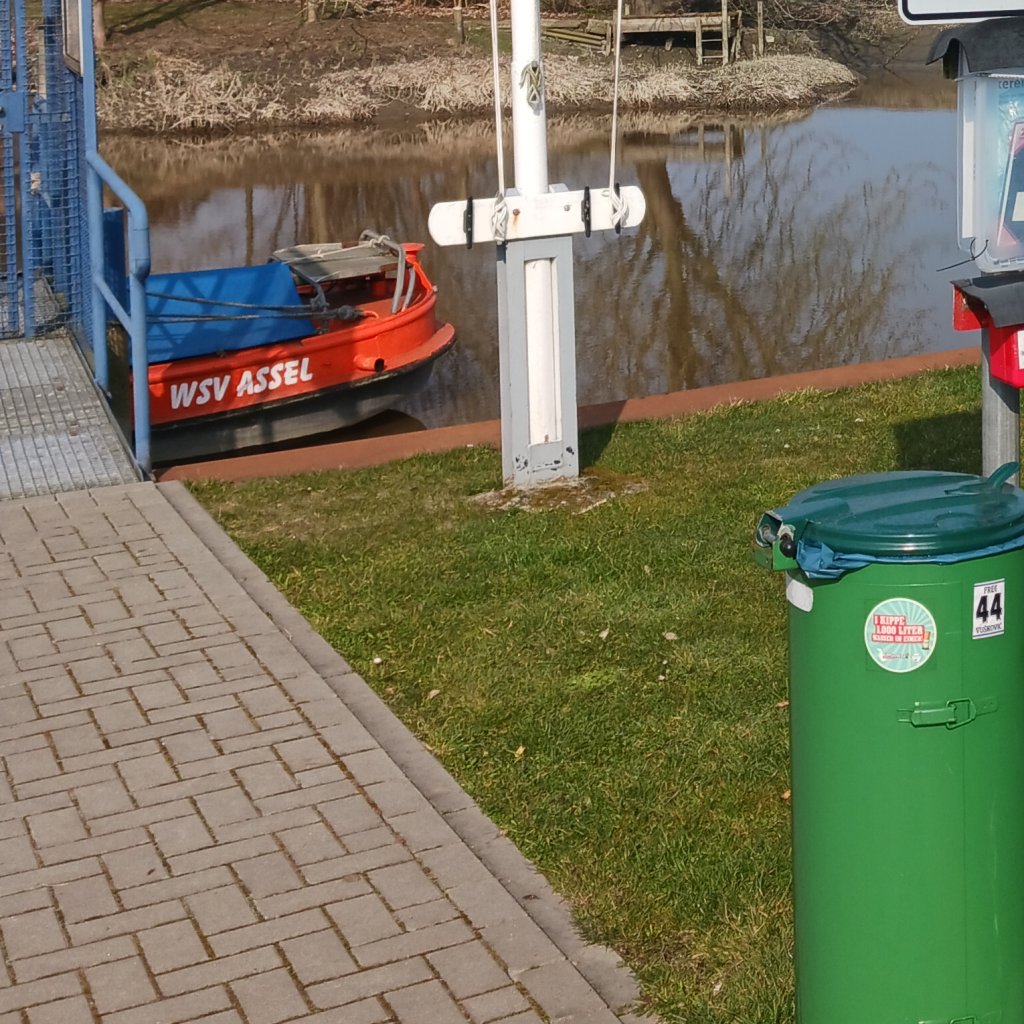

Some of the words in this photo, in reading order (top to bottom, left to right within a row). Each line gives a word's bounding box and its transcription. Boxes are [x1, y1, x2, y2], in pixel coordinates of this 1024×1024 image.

[170, 374, 231, 409] WSV
[236, 357, 313, 397] ASSEL
[983, 584, 998, 594] FREE
[976, 592, 1002, 623] 44
[880, 615, 906, 625] KIPPE
[898, 626, 923, 635] LITER
